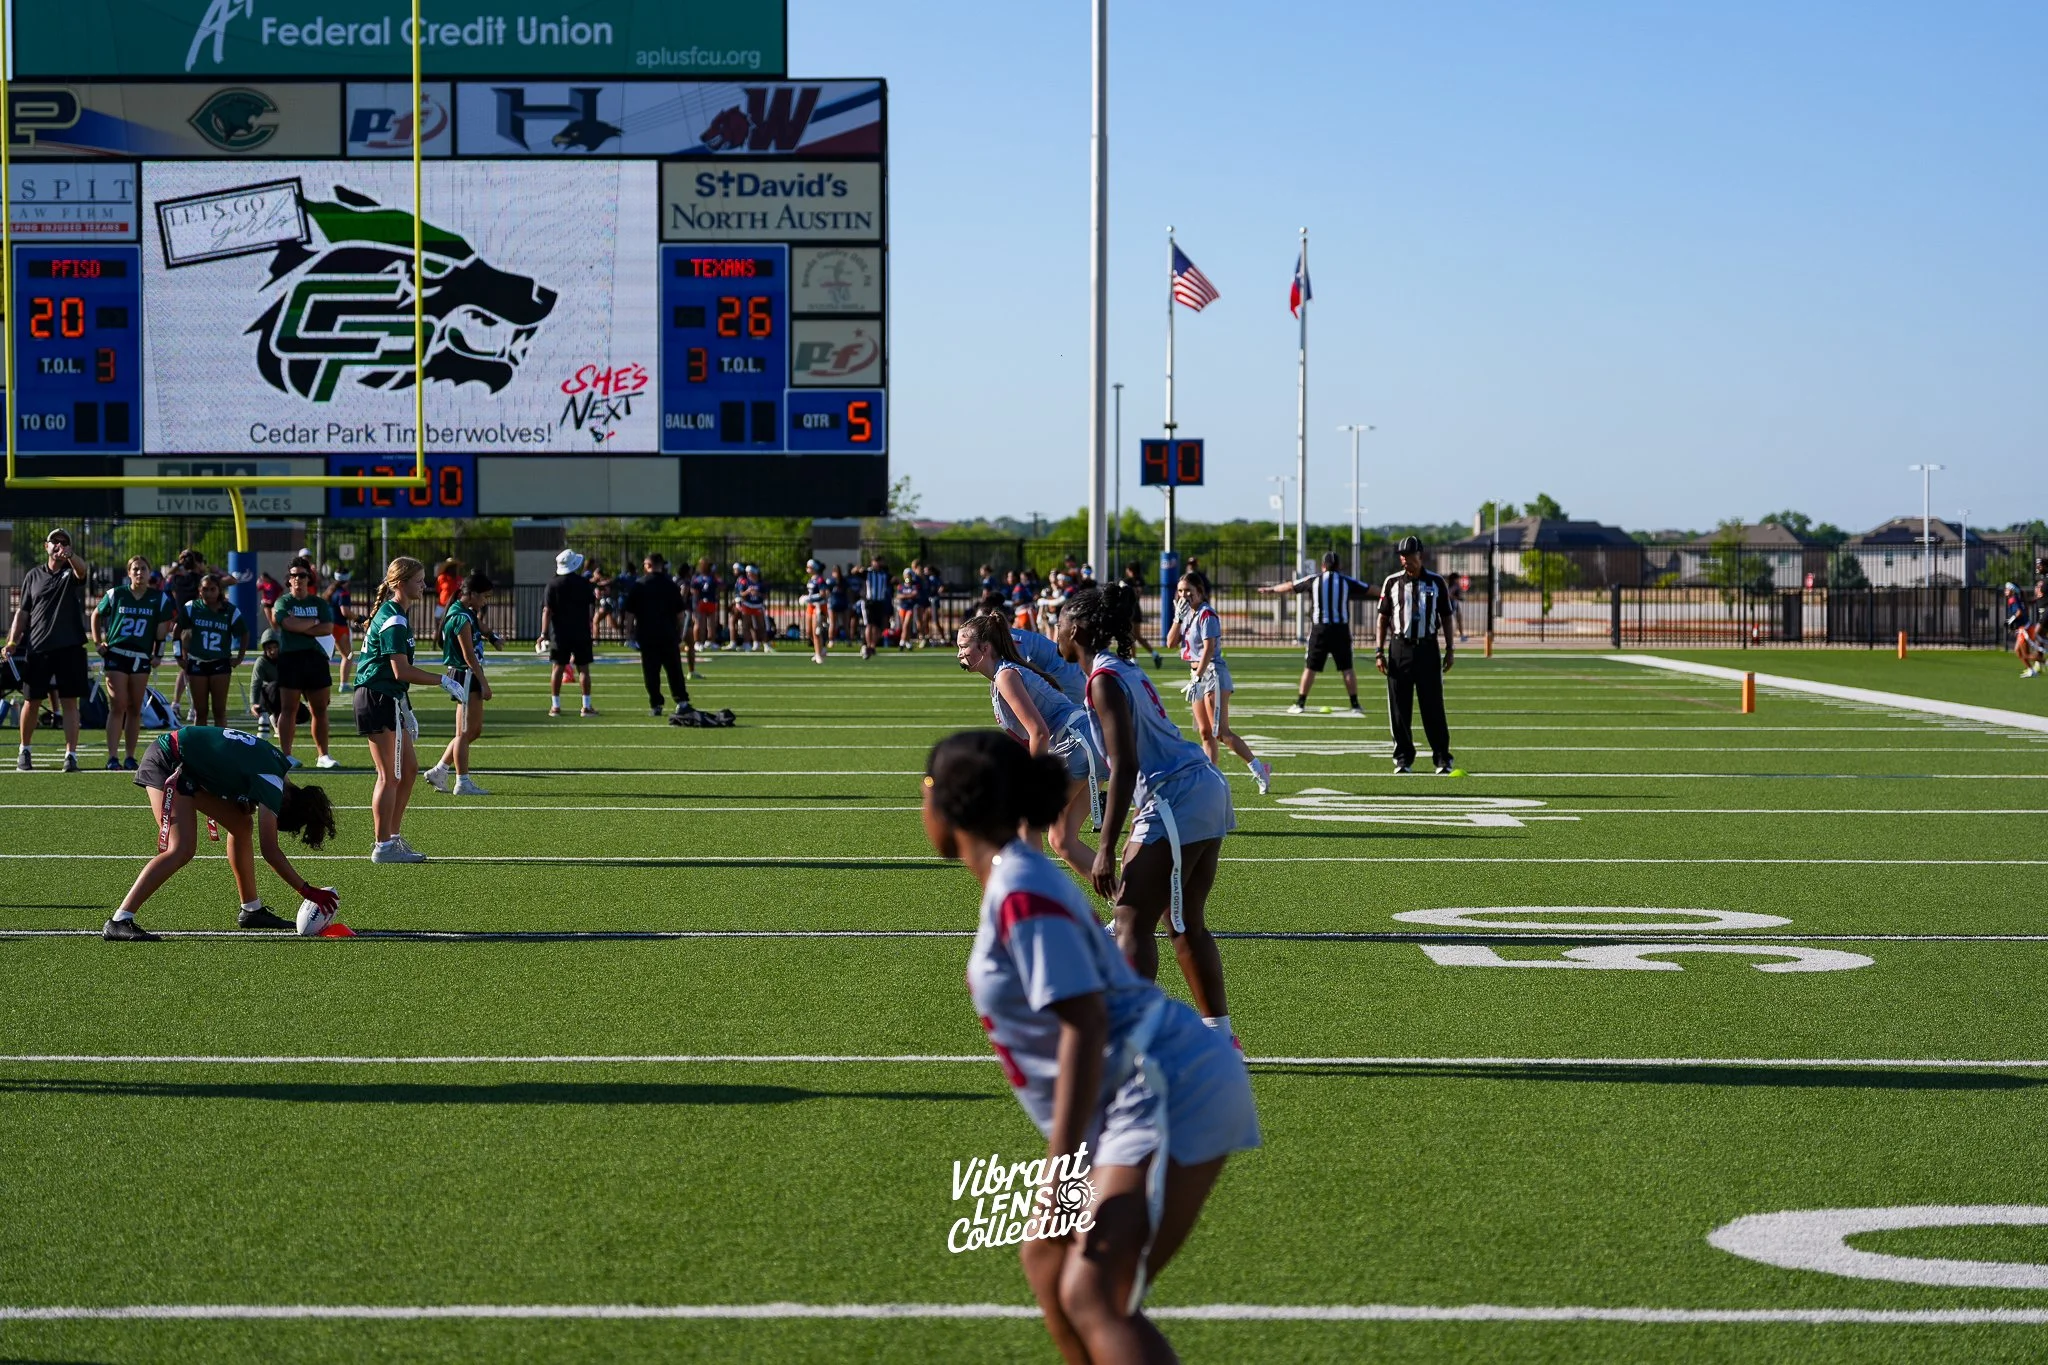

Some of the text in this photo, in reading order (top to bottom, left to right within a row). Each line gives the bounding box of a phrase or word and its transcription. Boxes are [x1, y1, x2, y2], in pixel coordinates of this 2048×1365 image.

[262, 16, 613, 46] Federal Credit Union
[635, 47, 761, 69] aplusfcu.org
[20, 179, 134, 200] SPIT
[62, 207, 114, 218] FIRM
[671, 203, 873, 229] NORTH AUSTIN
[52, 260, 101, 278] PFISD
[690, 258, 757, 278] TEXANS
[30, 297, 85, 338] 20
[717, 296, 772, 336] 26
[41, 358, 81, 373] T.O.L.
[97, 348, 115, 382] 3
[688, 347, 708, 382] 3
[721, 357, 762, 373] T.O.L.
[561, 363, 649, 396] SHE'S
[560, 391, 645, 430] NEXT
[665, 413, 715, 429] BALL ON
[802, 413, 830, 429] QTR
[847, 401, 873, 441] 5
[22, 414, 66, 430] TO GO
[249, 421, 552, 445] Cedar Park Timberwolves!
[1145, 441, 1200, 482] 40
[156, 498, 219, 511] LIVING
[118, 606, 153, 616] CEDAR PARK
[120, 618, 148, 637] 20
[214, 621, 228, 630] PARK
[200, 630, 222, 651] 12
[165, 787, 174, 809] COME
